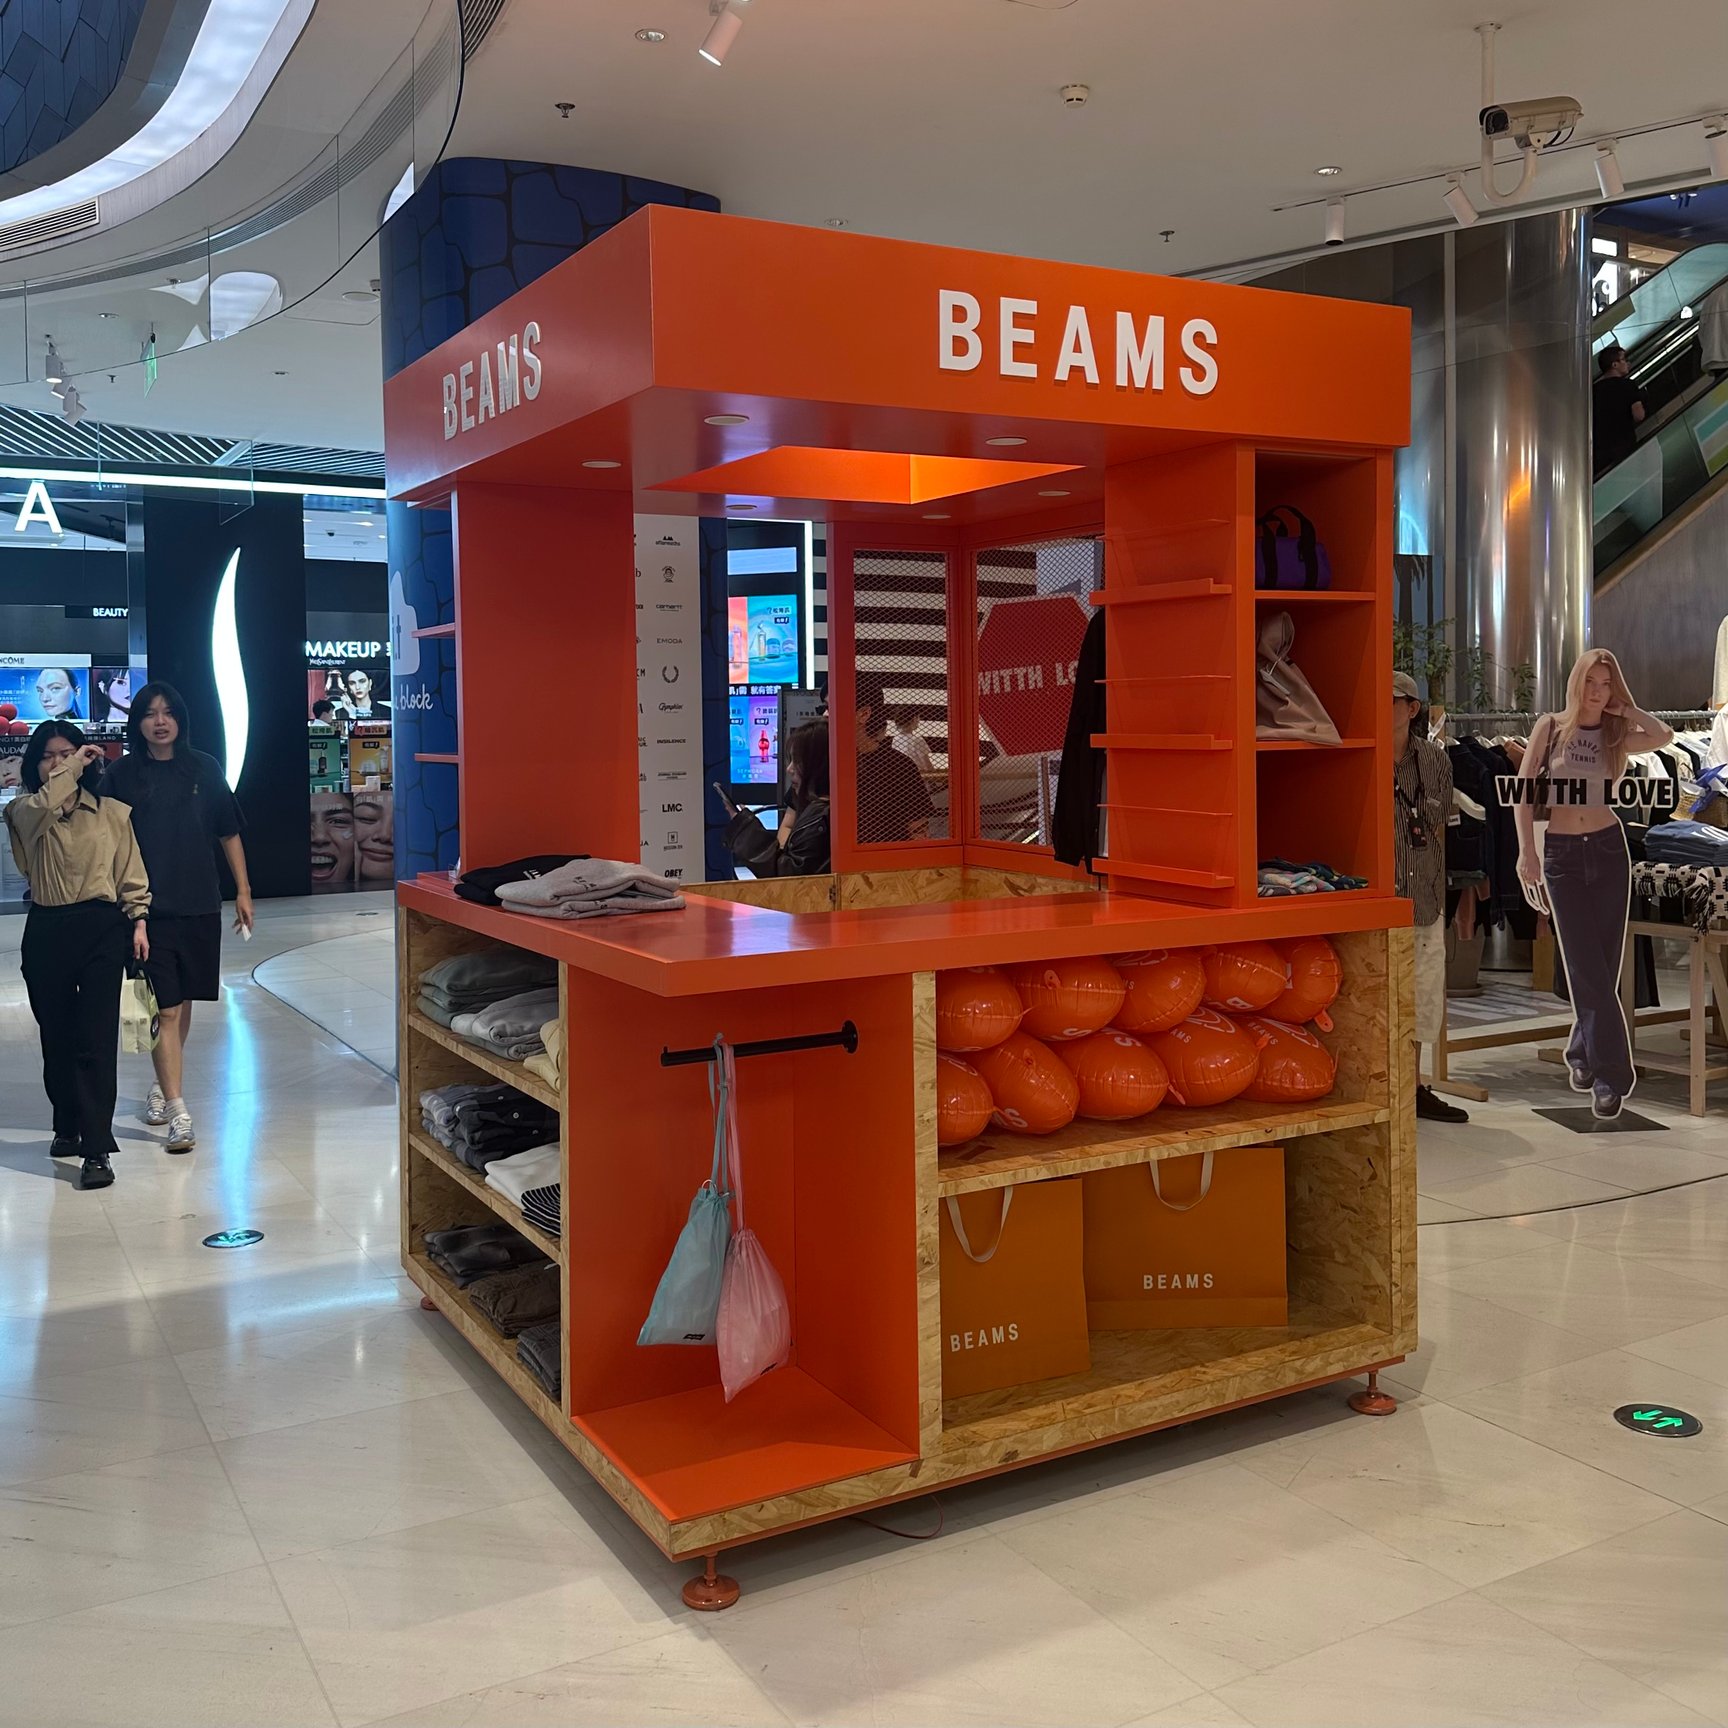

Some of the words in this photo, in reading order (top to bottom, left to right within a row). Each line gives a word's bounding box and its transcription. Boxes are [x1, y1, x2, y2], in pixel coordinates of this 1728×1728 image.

[939, 289, 1219, 395] BEAMS
[443, 321, 542, 441] BEAMS
[14, 480, 63, 534] A
[93, 607, 129, 617] BEAUTY
[305, 640, 382, 658] MAKEUP
[400, 683, 434, 710] block
[1571, 753, 1596, 763] TENNIS
[1497, 777, 1588, 805] WITTH
[1603, 778, 1673, 806] LOVE
[661, 803, 684, 813] LMC
[664, 868, 684, 878] OBEY
[1142, 1273, 1215, 1290] BEAMS
[951, 1323, 1020, 1352] BEAMS
